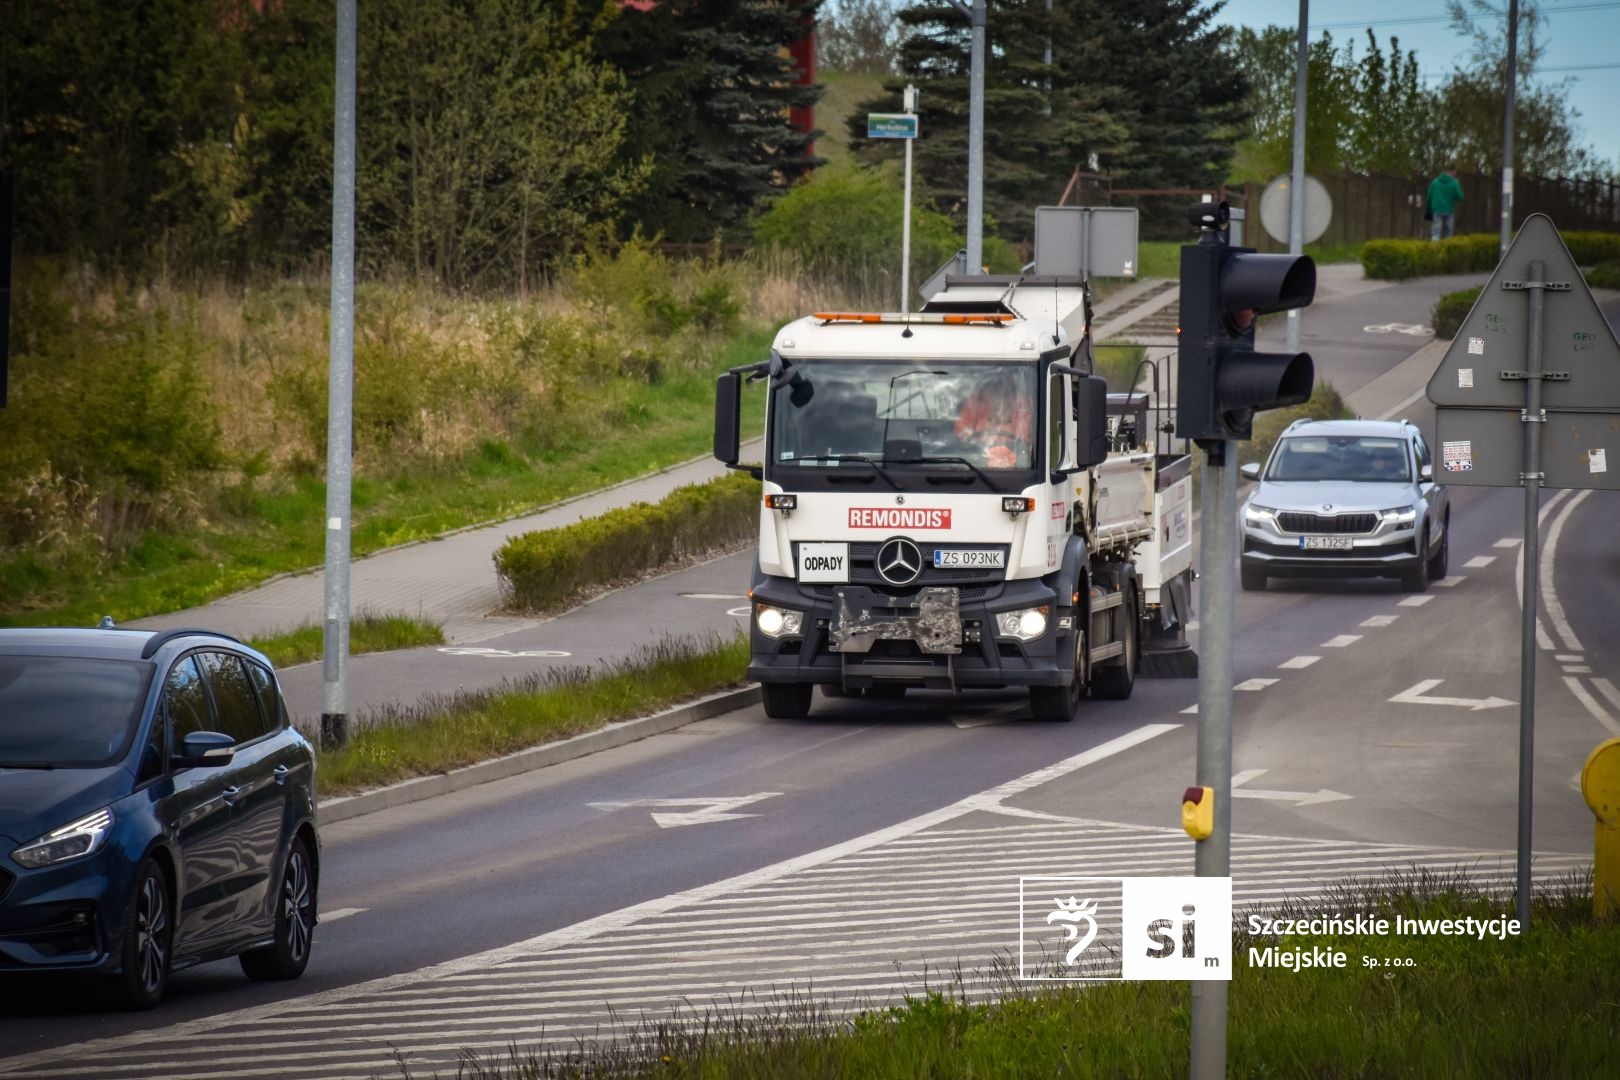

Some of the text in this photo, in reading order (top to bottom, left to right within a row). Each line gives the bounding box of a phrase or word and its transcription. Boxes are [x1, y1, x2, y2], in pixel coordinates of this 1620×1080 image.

[1306, 537, 1318, 548] ZS
[804, 556, 843, 571] ODPADY
[943, 552, 1000, 565] ZS 093NK
